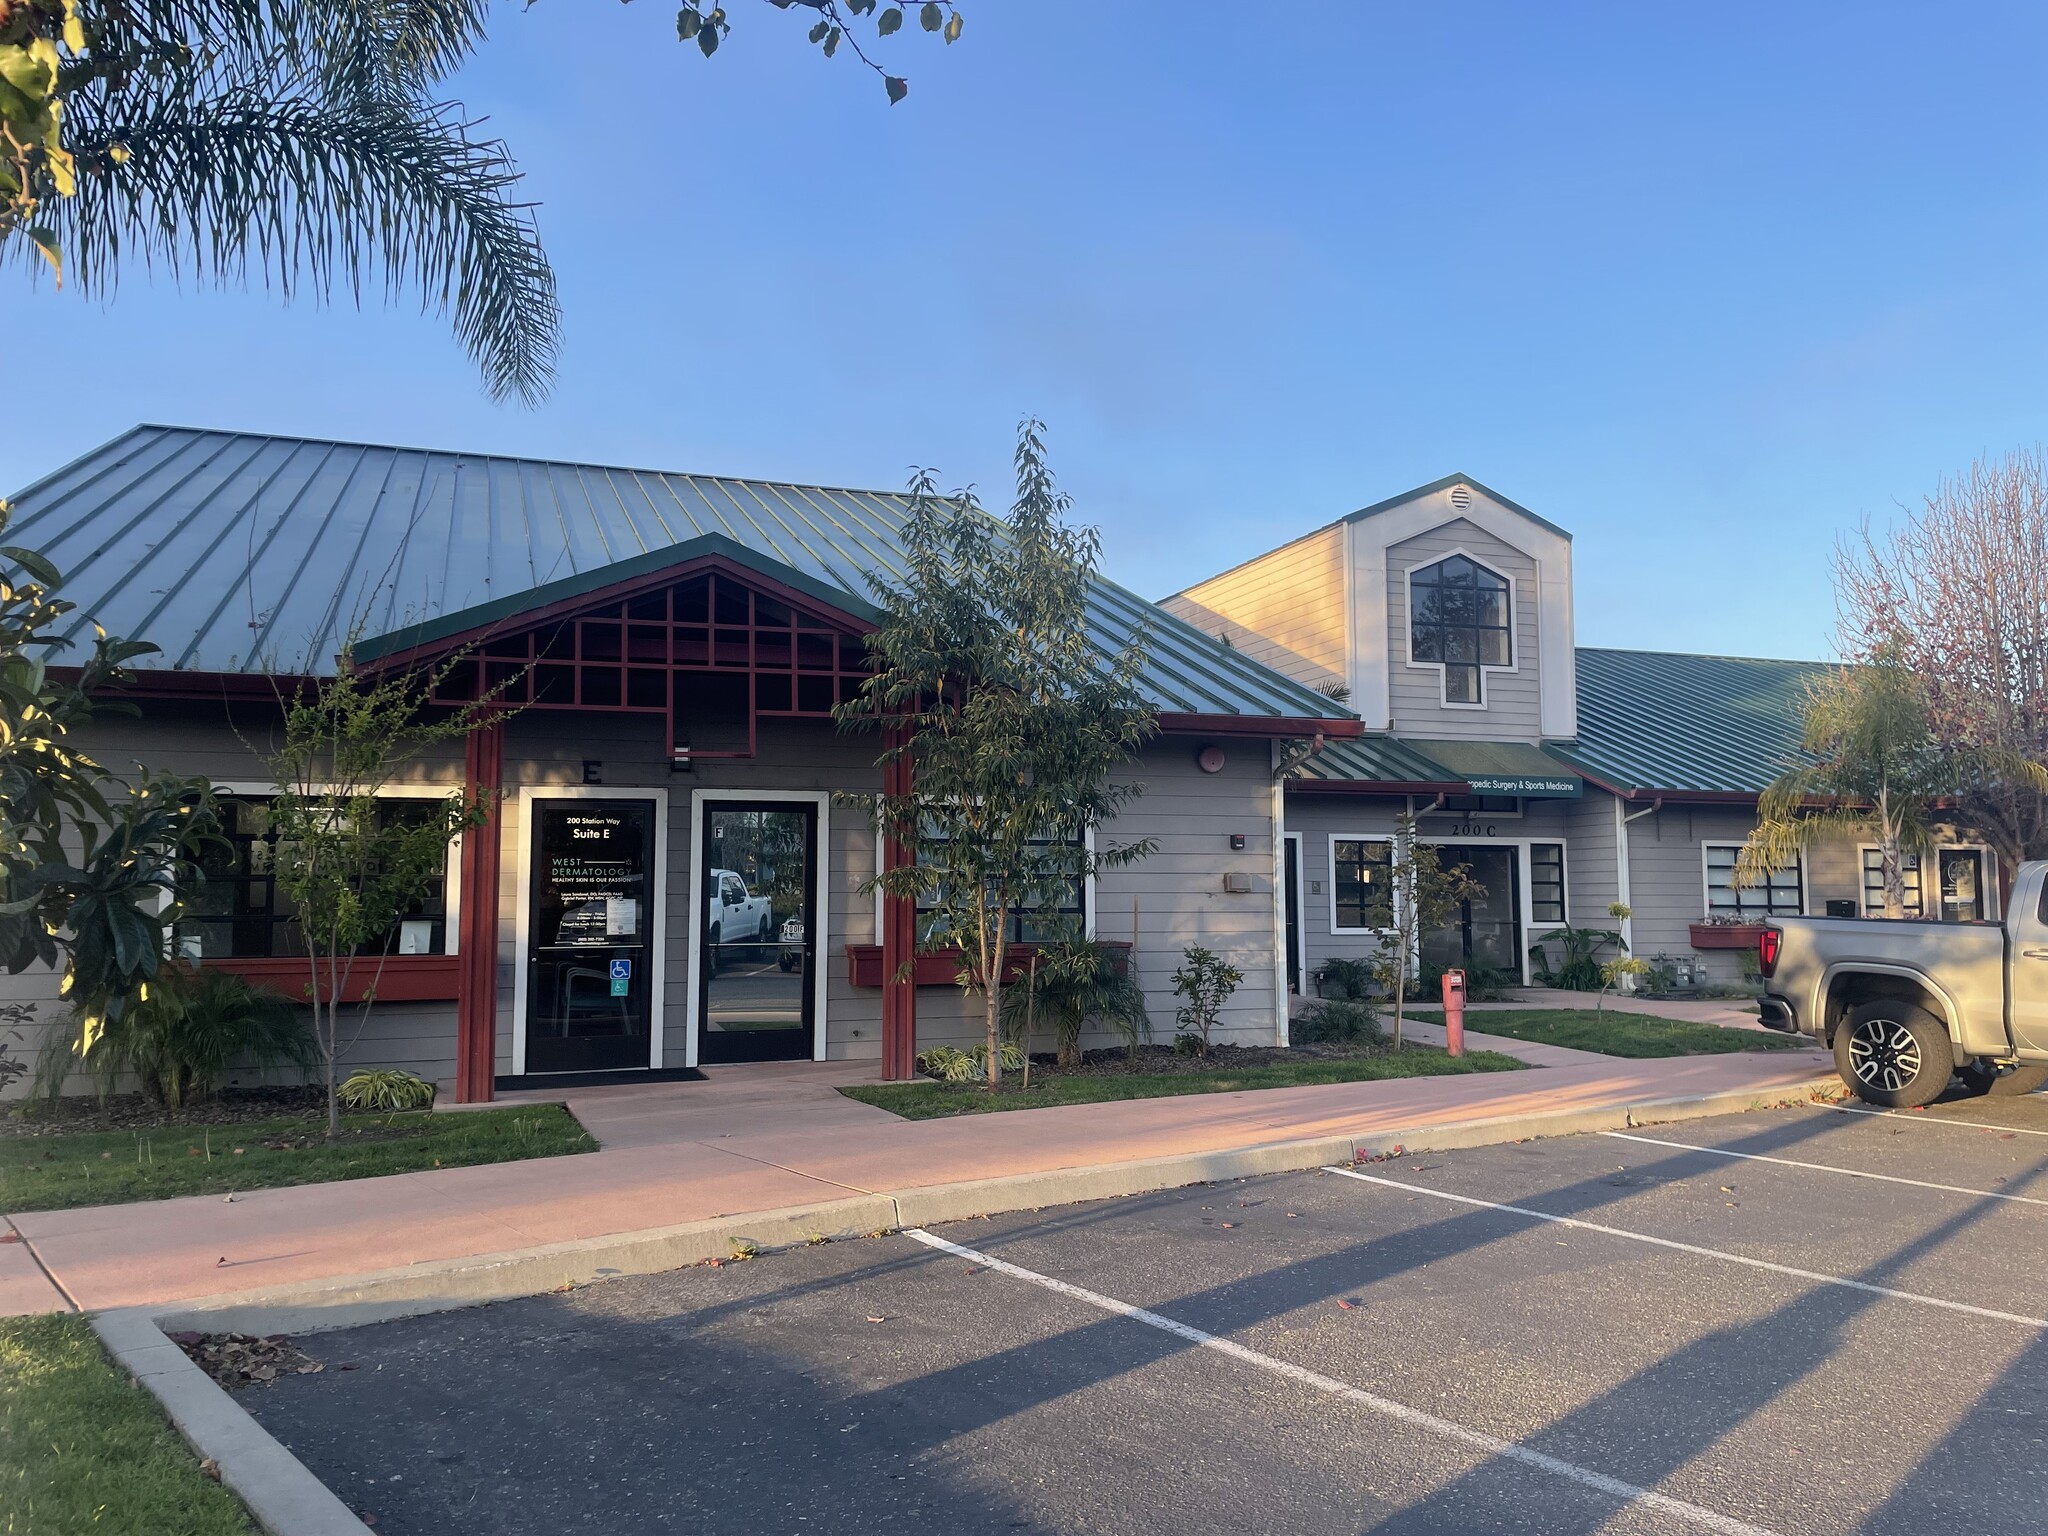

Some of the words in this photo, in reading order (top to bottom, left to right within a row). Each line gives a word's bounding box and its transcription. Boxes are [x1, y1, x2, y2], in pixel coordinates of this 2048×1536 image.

[583, 760, 602, 784] E
[1492, 780, 1517, 791] Surgery
[1518, 780, 1524, 789] &
[1525, 780, 1545, 791] Sports
[1546, 781, 1574, 791] Medicine
[581, 817, 605, 825] Station
[606, 818, 621, 826] Way
[573, 828, 600, 839] Suite
[603, 829, 610, 839] E
[716, 827, 722, 837] F
[1452, 825, 1480, 836] 200
[1487, 825, 1496, 837] C
[552, 858, 581, 866] WEST
[552, 868, 632, 876] DERMATOLOGY
[785, 925, 798, 933] 200
